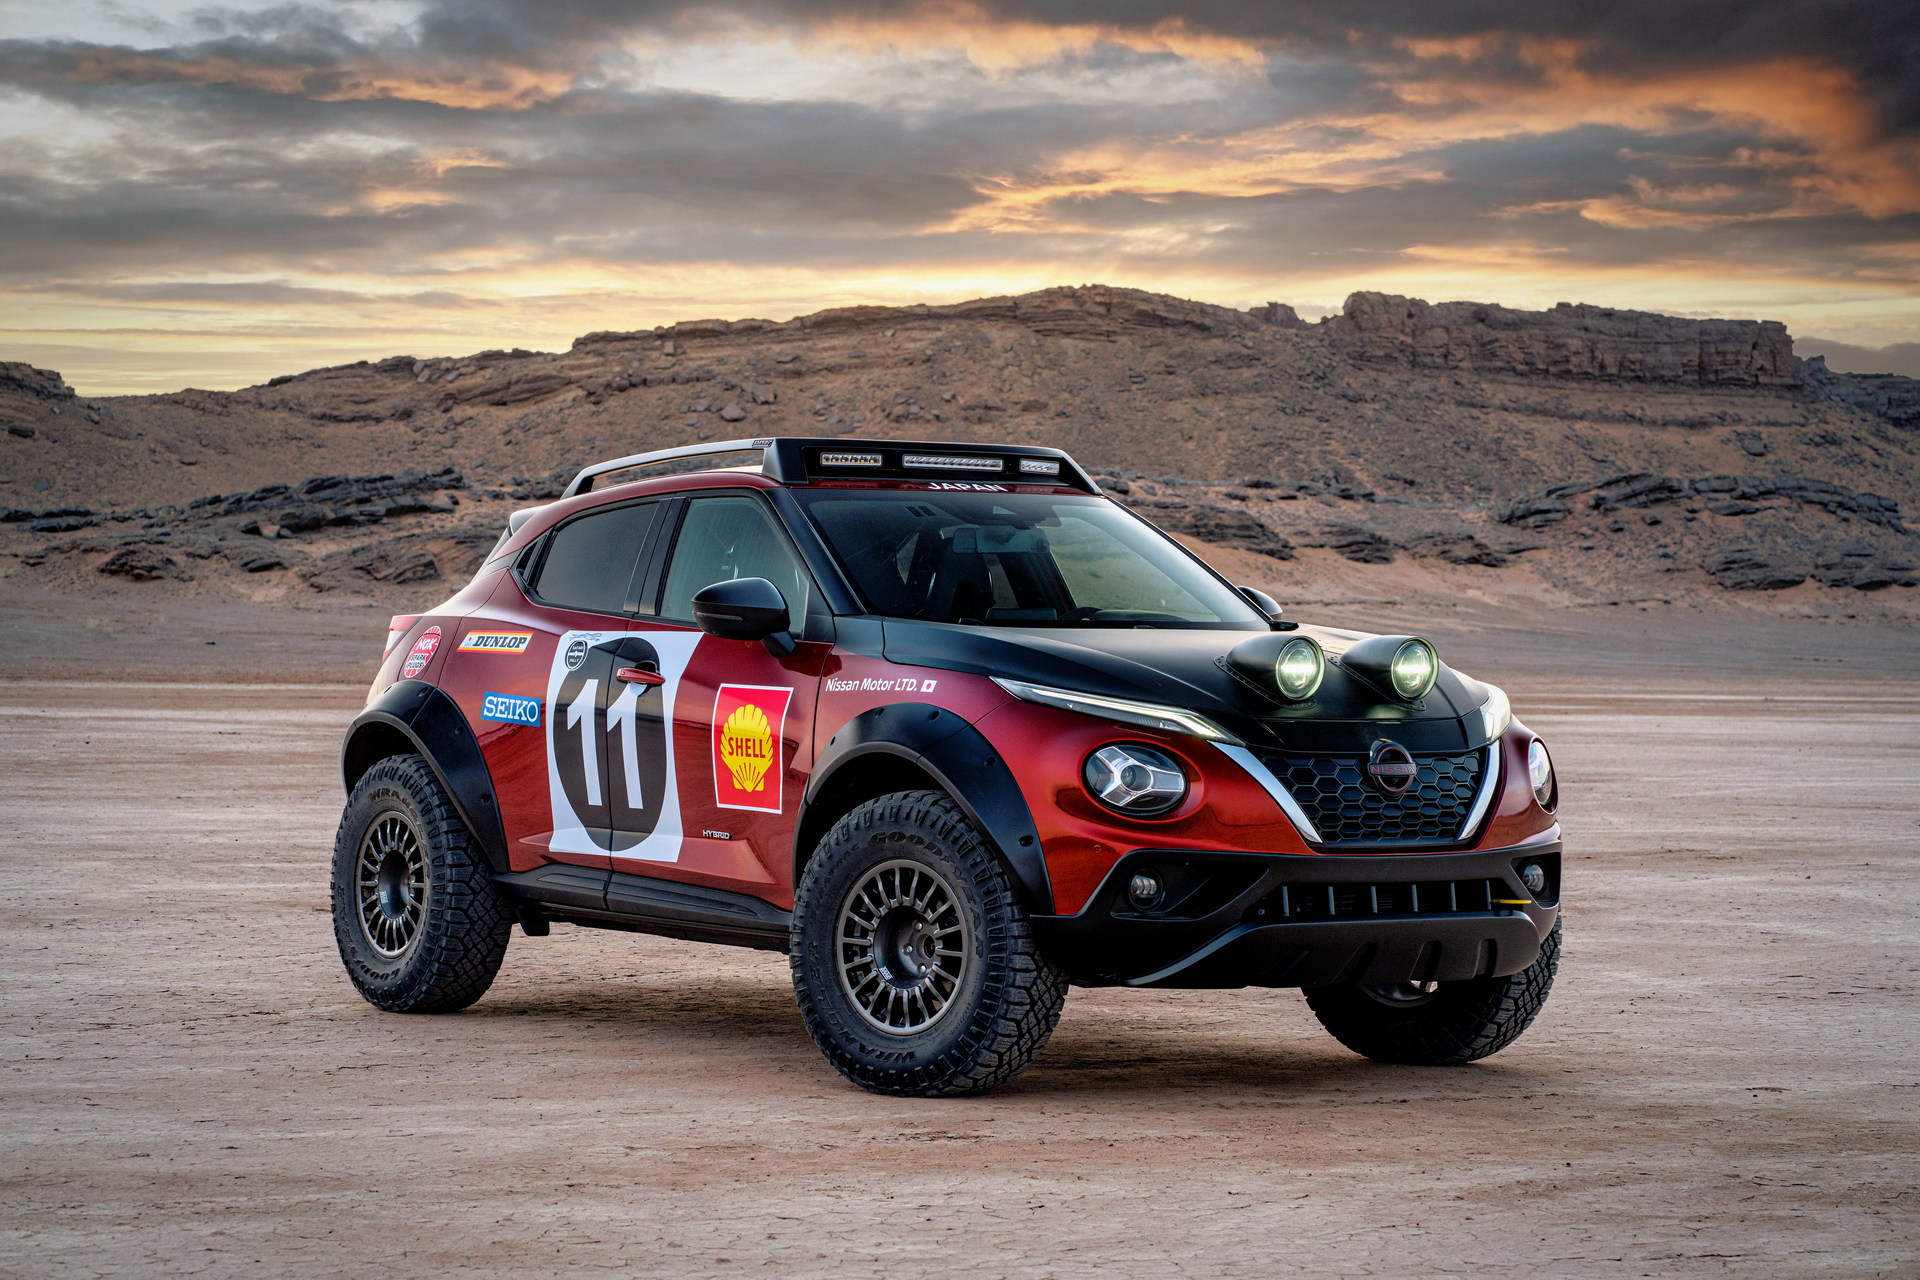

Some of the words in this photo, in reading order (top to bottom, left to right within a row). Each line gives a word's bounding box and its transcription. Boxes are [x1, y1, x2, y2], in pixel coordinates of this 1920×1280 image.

[928, 482, 1009, 492] JAPAN
[415, 638, 436, 650] NGK
[473, 635, 527, 649] DUNLOP
[825, 677, 859, 692] Nissan
[860, 677, 894, 691] Motor
[894, 678, 917, 692] LTD.
[483, 695, 539, 723] SEIKO
[566, 678, 644, 810] 11
[728, 736, 766, 758] SHELL
[1371, 764, 1415, 774] NISSAN
[703, 829, 731, 839] HYBRID
[868, 830, 984, 960] GOODYEAR
